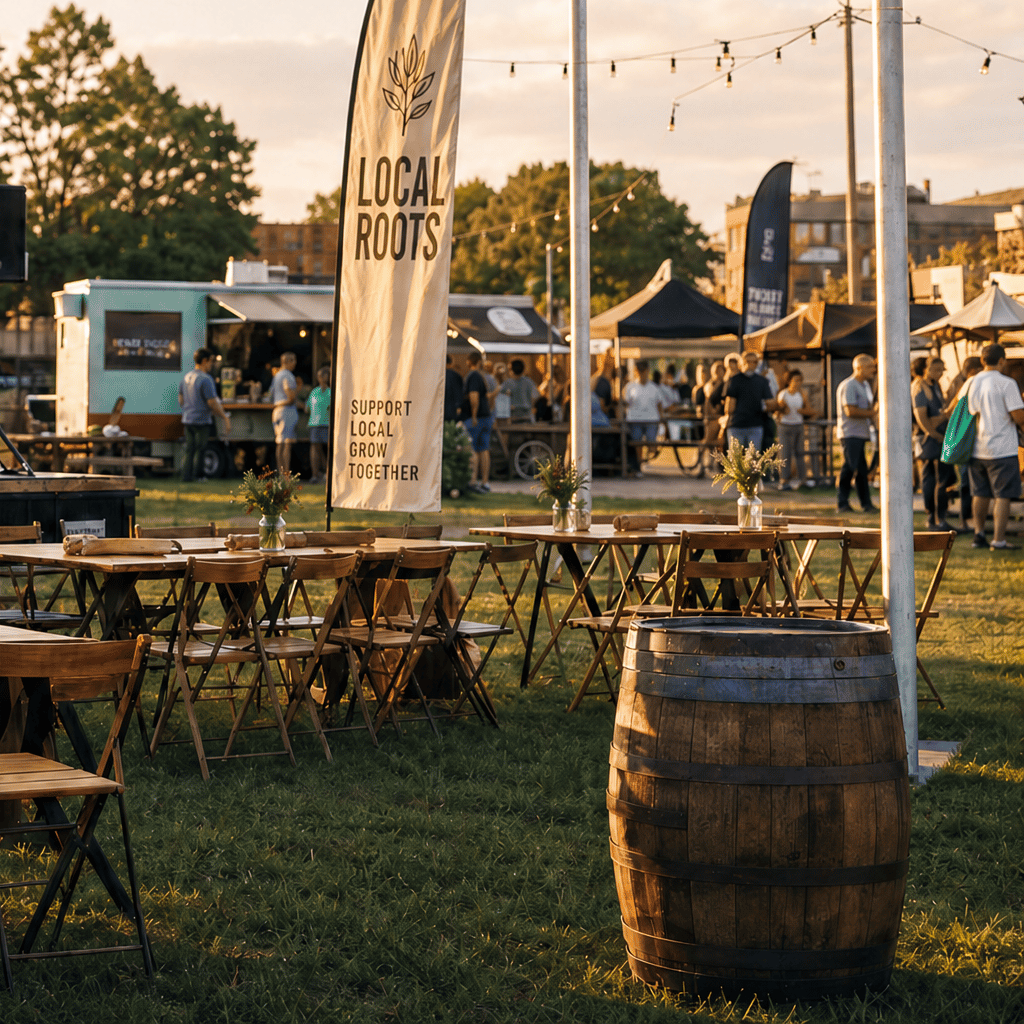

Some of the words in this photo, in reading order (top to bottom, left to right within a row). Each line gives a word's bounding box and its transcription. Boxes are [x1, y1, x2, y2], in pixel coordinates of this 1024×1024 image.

[357, 156, 445, 207] LOCAL
[354, 211, 441, 261] ROOTS
[351, 399, 412, 416] SUPPORT
[350, 420, 394, 437] LOCAL
[349, 441, 388, 458] GROW
[348, 462, 419, 481] TOGETHER
